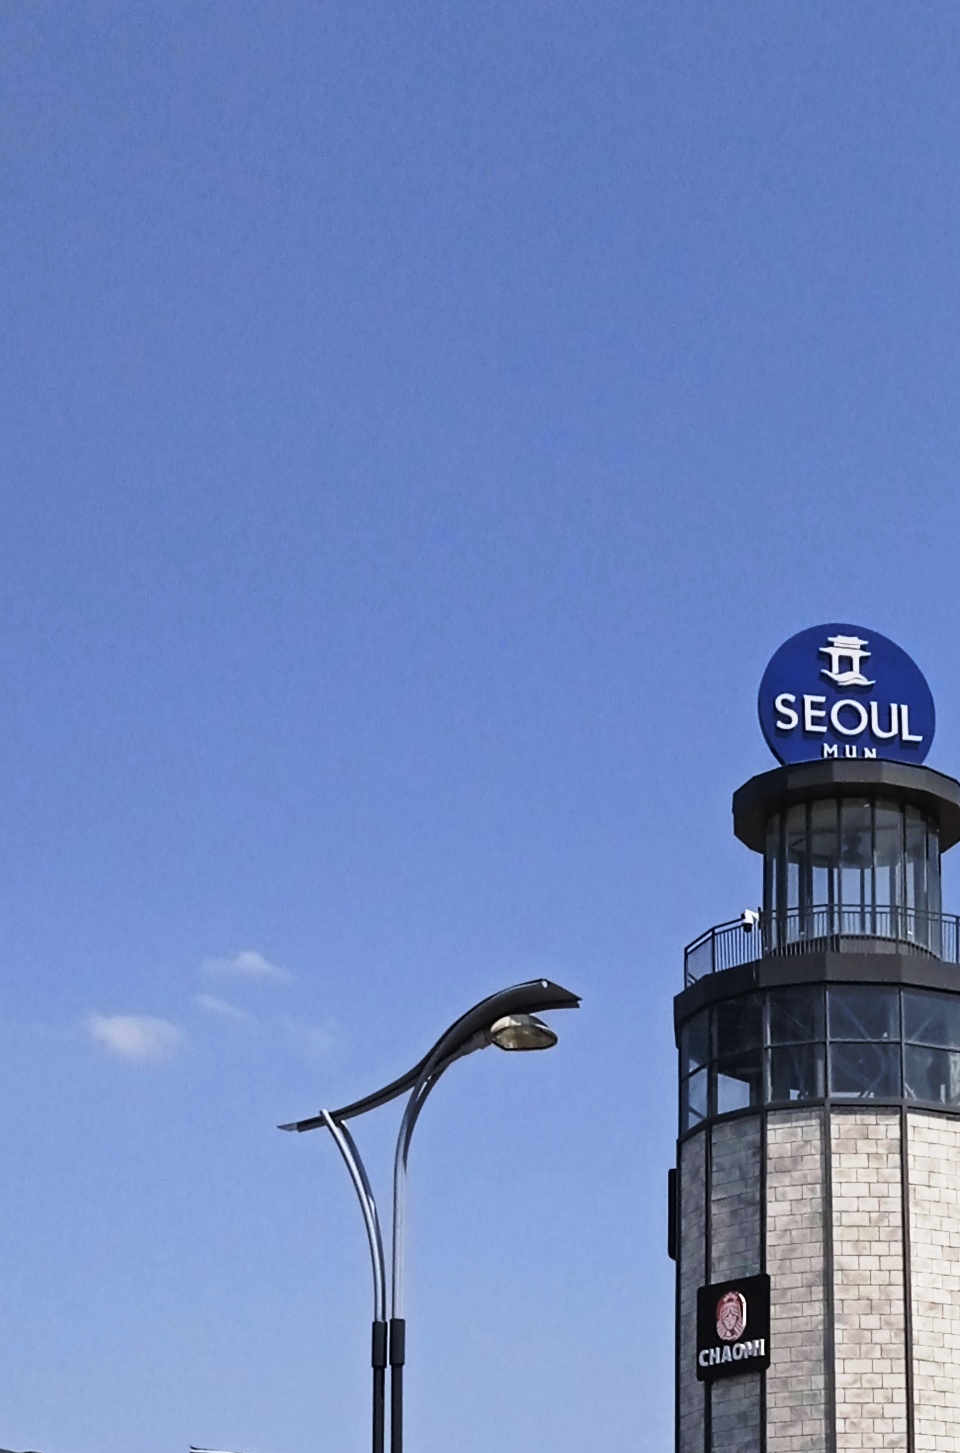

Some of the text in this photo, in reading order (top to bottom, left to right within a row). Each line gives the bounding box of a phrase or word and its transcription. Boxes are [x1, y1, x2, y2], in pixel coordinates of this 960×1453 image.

[774, 693, 923, 742] SEOUL
[823, 743, 877, 759] MUN
[698, 1339, 765, 1367] CHAOMI
